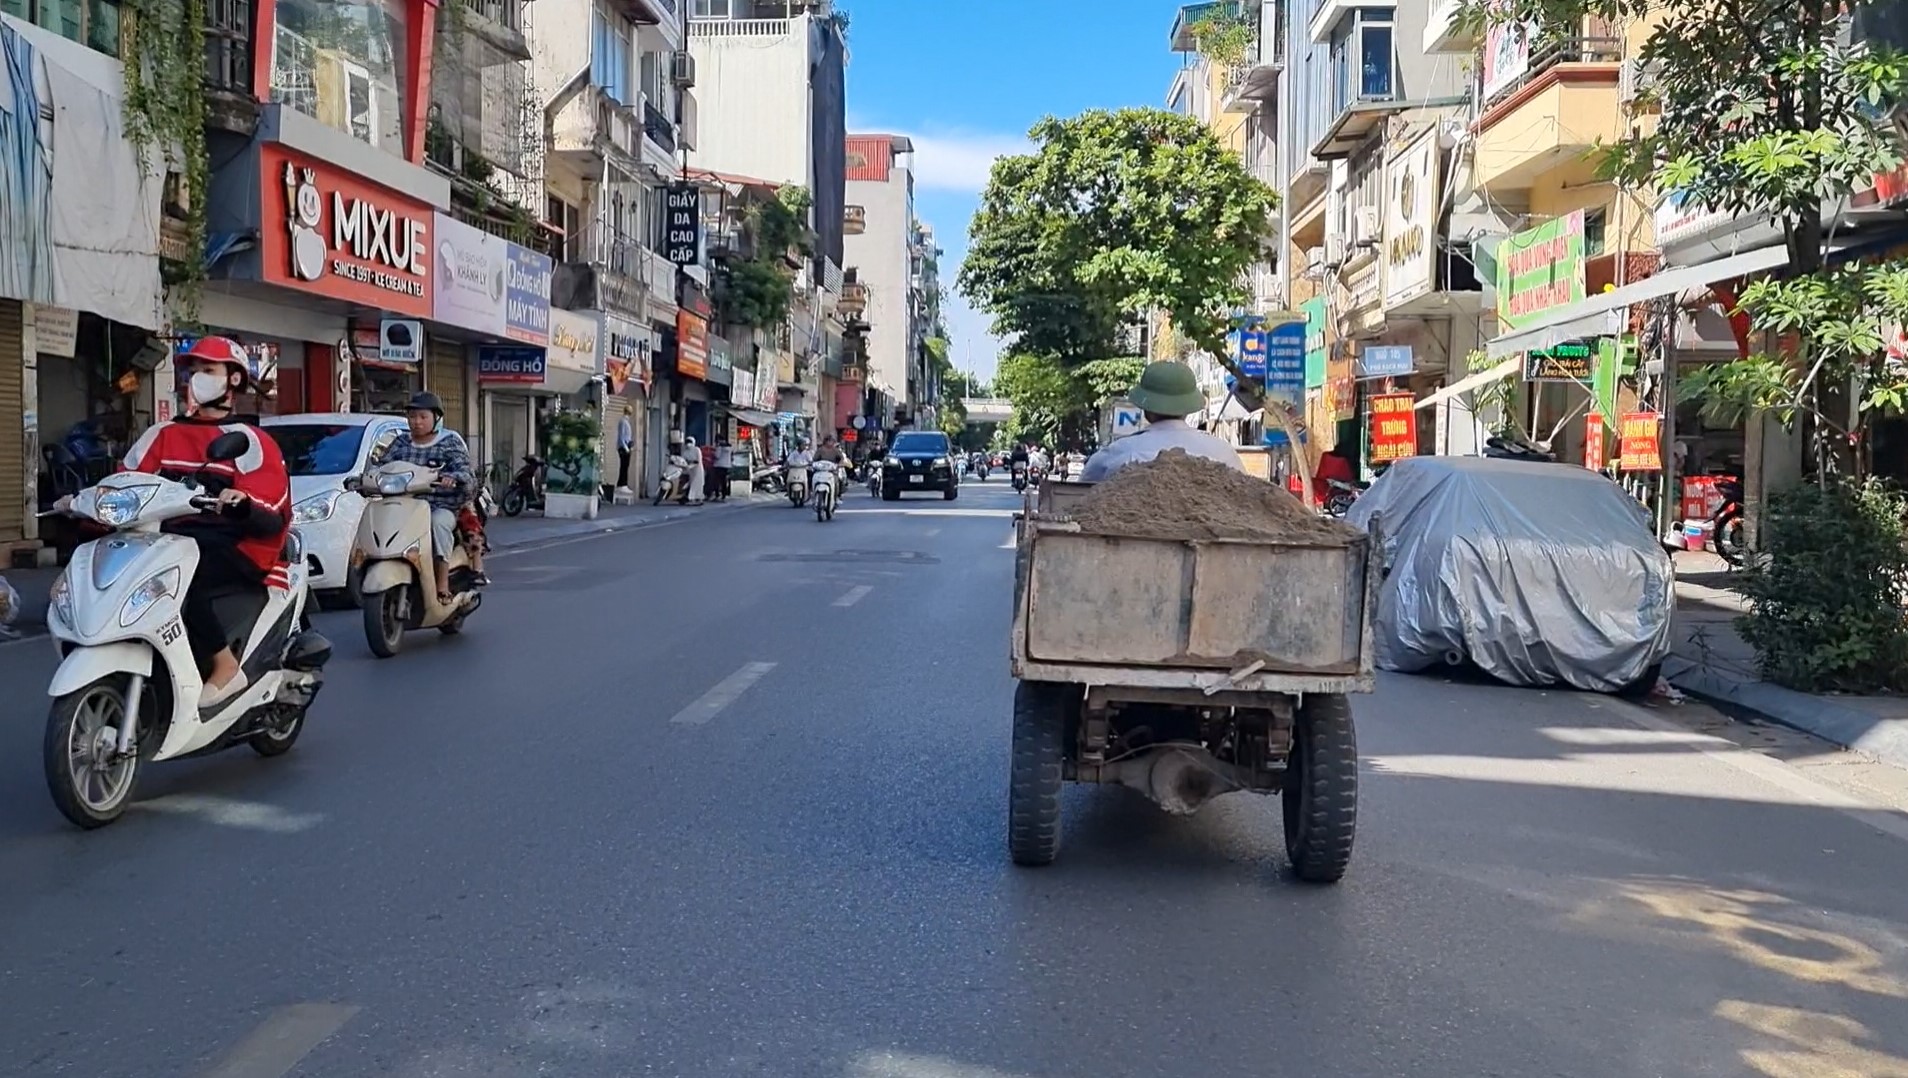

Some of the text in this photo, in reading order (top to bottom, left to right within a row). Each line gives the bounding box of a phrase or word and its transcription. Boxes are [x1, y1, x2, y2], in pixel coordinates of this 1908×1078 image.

[674, 212, 690, 225] DA
[334, 190, 426, 276] MIXUE
[670, 230, 694, 243] CAO
[670, 245, 693, 262] CẤP
[334, 260, 356, 279] SINCE
[356, 265, 371, 283] 1997
[374, 270, 385, 288] ICE
[385, 273, 406, 293] CREAM
[414, 281, 424, 297] TEA
[508, 297, 527, 324] MÁY
[529, 302, 547, 330] TÍNH
[481, 355, 542, 373] ĐỒNG HỒ
[161, 622, 182, 646] 50
